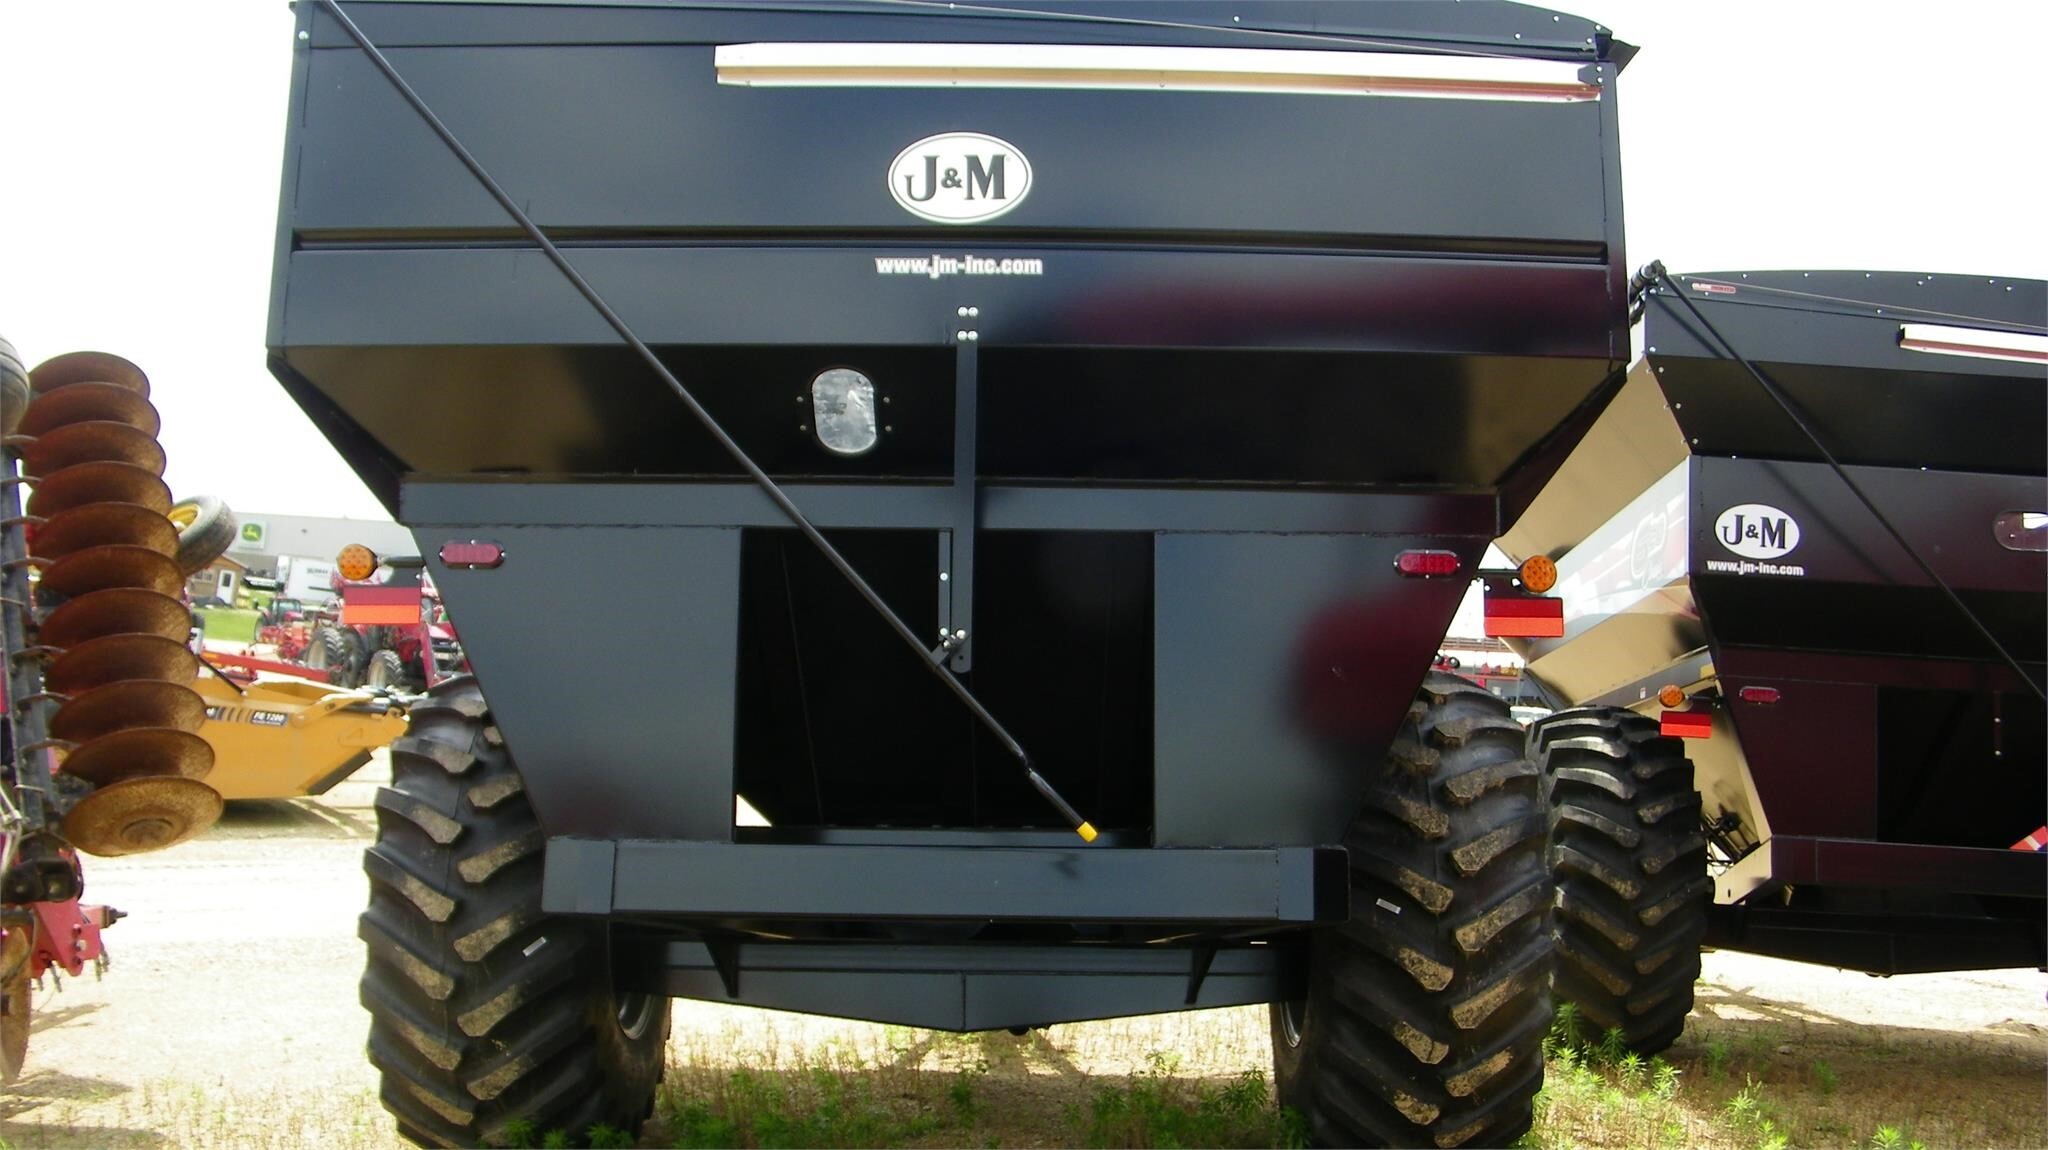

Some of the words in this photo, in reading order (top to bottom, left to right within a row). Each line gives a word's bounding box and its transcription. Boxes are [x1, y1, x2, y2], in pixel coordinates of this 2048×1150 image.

[904, 154, 1007, 202] J&M
[875, 254, 1043, 279] www.jm-inc.com
[1721, 513, 1788, 549] J&M
[1706, 560, 1805, 576] www.jm-inc.com
